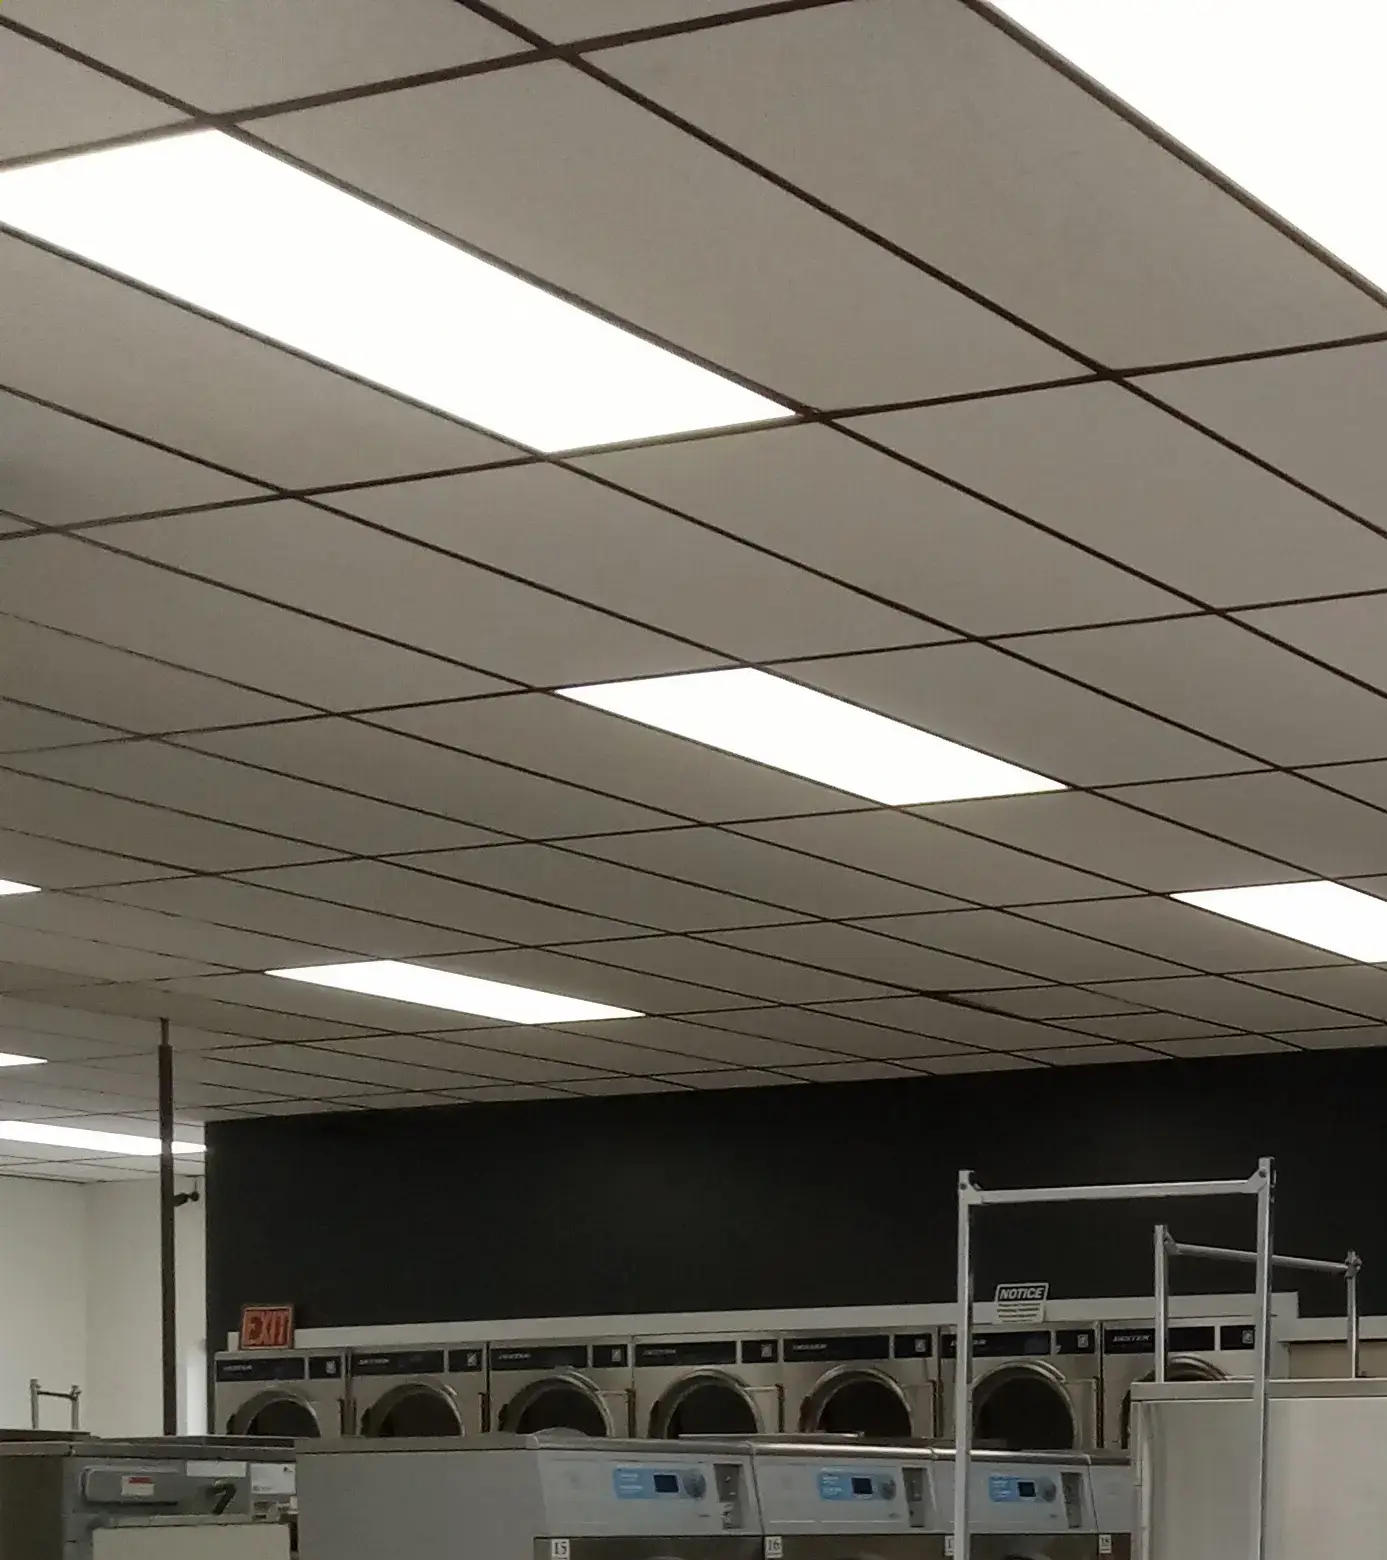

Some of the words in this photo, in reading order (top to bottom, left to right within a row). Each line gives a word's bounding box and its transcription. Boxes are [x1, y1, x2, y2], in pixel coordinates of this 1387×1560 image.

[1000, 1287, 1044, 1299] NOTICE
[244, 1311, 289, 1345] EXIT
[554, 1541, 567, 1555] 15
[768, 1539, 780, 1551] 16
